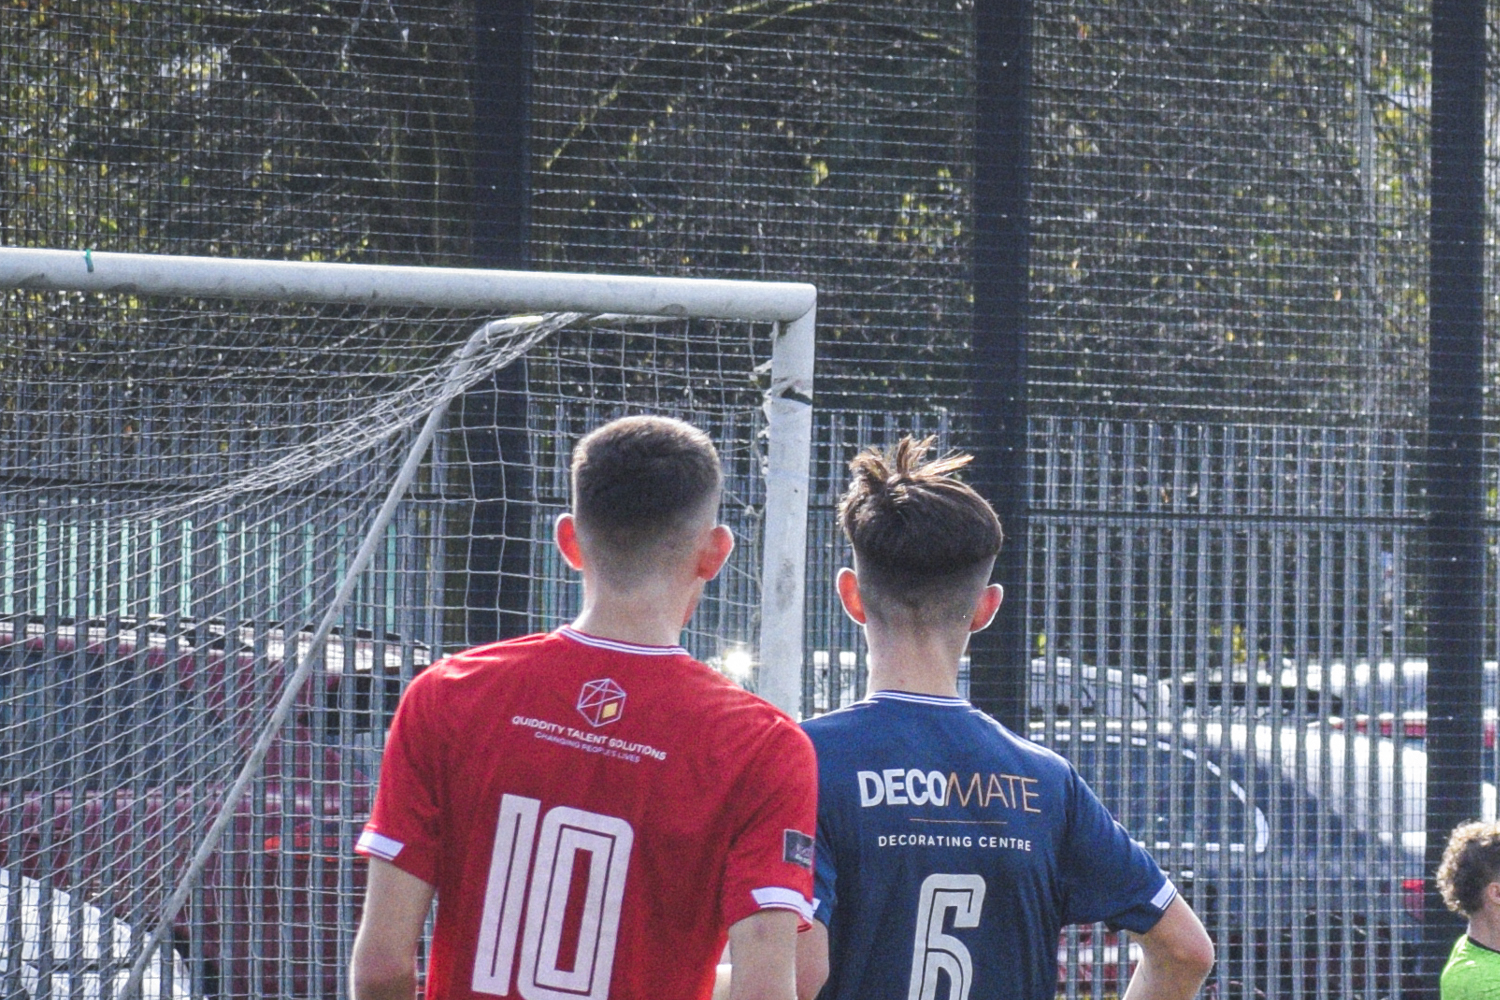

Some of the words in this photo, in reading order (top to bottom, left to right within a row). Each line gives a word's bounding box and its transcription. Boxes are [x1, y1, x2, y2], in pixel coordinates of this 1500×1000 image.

[511, 715, 566, 735] QUIDDITY
[566, 727, 609, 745] TALENT
[608, 738, 668, 761] SOLUTIONS
[857, 768, 1042, 813] DECOMATE
[878, 834, 972, 848] DECORATING
[978, 836, 1032, 852] CENTRE
